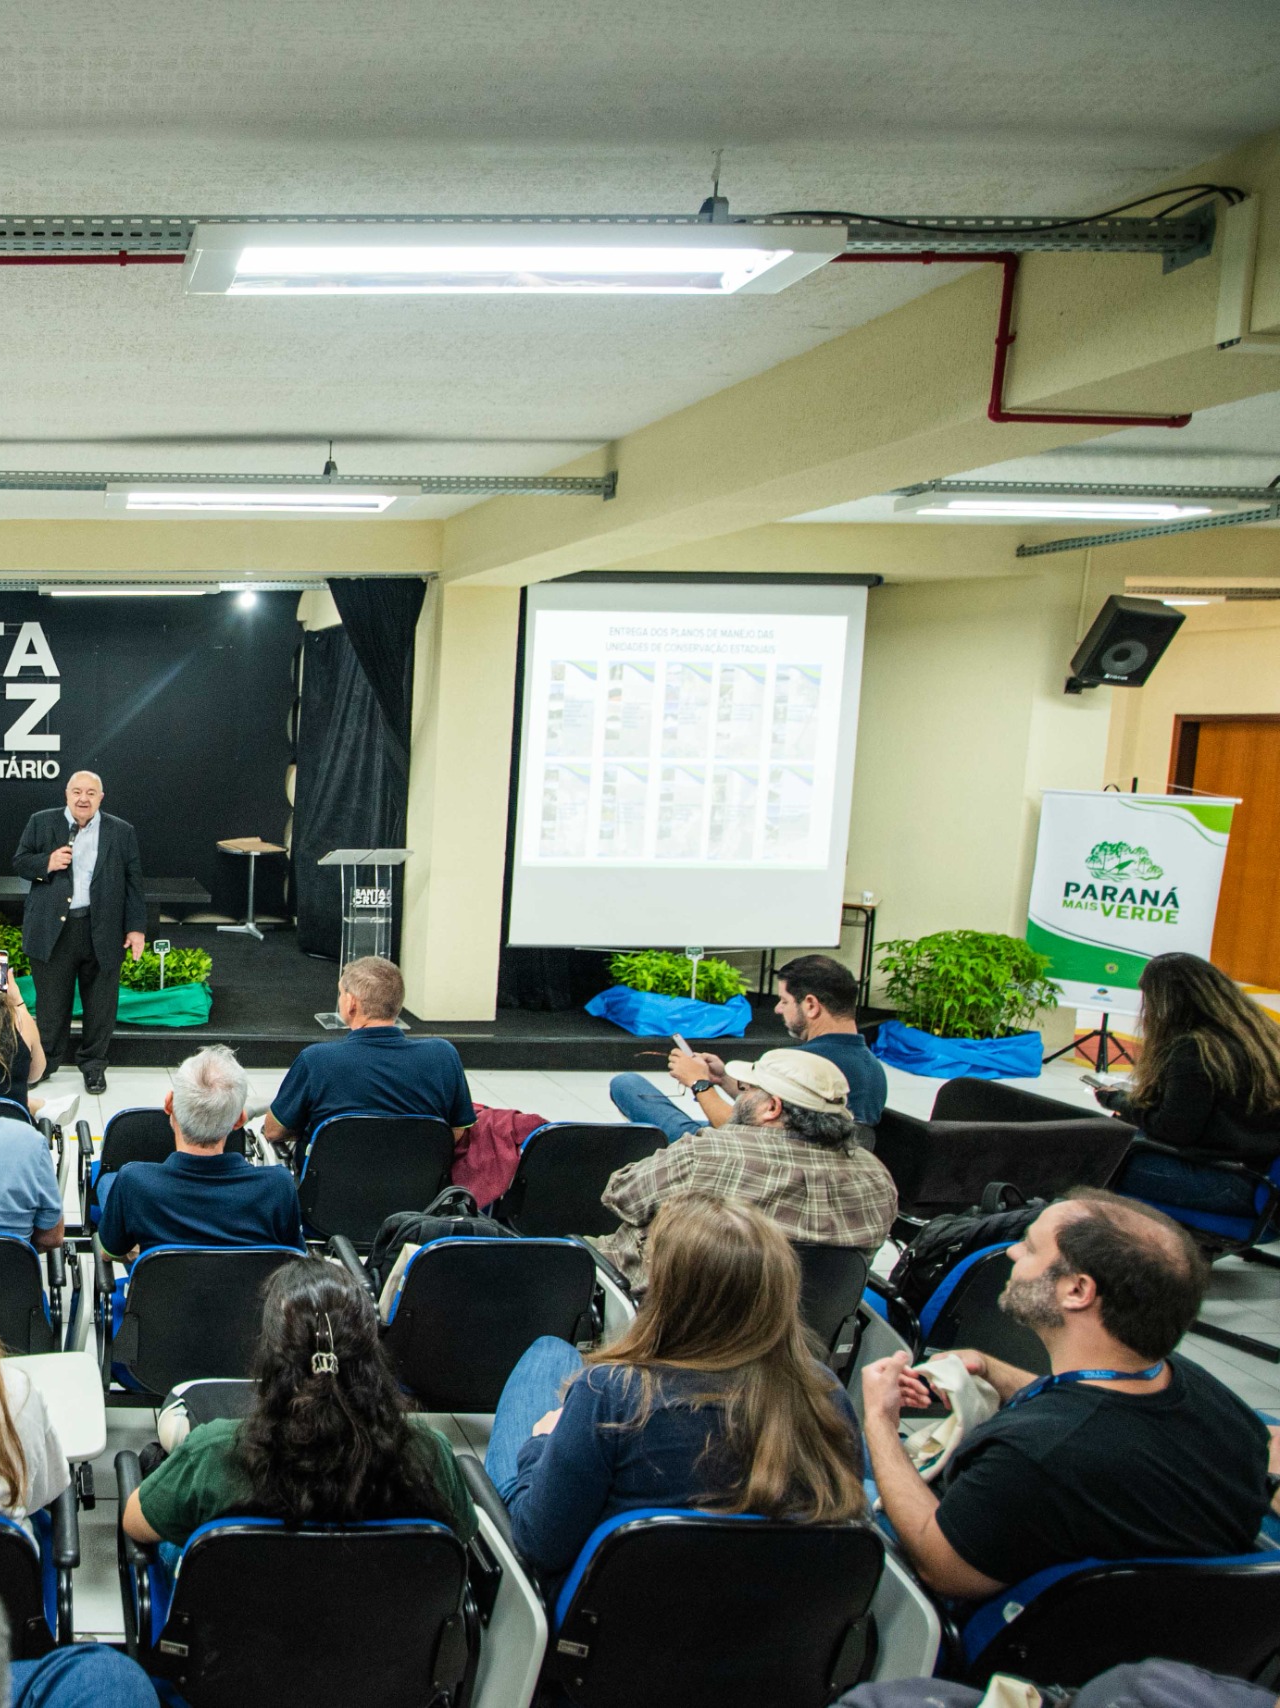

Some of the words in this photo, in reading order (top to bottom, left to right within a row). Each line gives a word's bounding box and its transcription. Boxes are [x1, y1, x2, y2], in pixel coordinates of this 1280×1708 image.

[608, 626, 649, 637] ENTREGA
[650, 627, 668, 637] DOS
[671, 628, 705, 638] PLANOS
[706, 628, 718, 638] DE
[720, 628, 756, 639] MANEJO
[757, 629, 775, 639] DAS
[605, 641, 649, 652] UNIDADES
[651, 642, 662, 652] DE
[730, 644, 776, 655] ESTADUAIS
[353, 888, 386, 897] SANTA
[1064, 882, 1180, 909] PARANÁ
[352, 895, 386, 904] CRUZ
[1062, 898, 1098, 911] MAIS
[1100, 902, 1180, 925] VERDE
